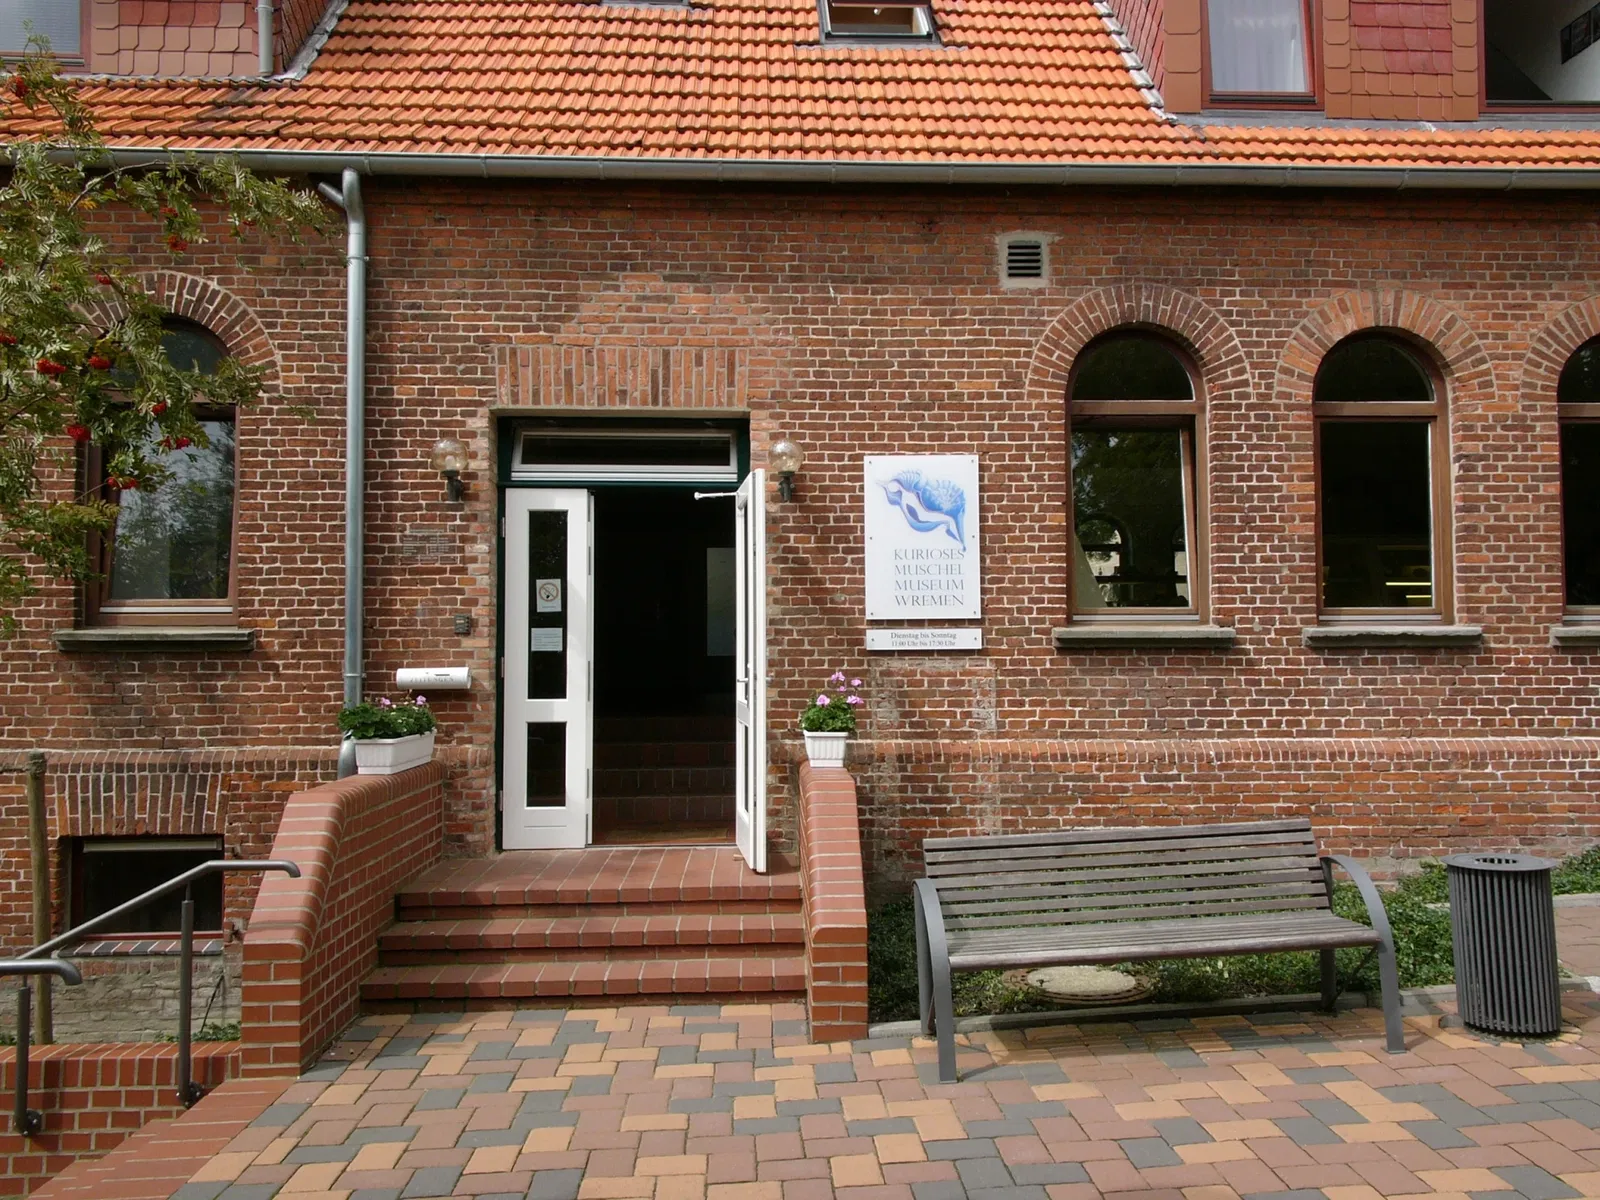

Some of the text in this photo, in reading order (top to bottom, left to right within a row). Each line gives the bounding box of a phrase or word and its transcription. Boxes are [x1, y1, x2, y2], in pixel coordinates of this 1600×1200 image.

[894, 549, 964, 560] KURIOSES
[894, 564, 964, 575] MUSCHEL
[895, 580, 964, 590] MUSEUM
[895, 595, 964, 606] WREMEN
